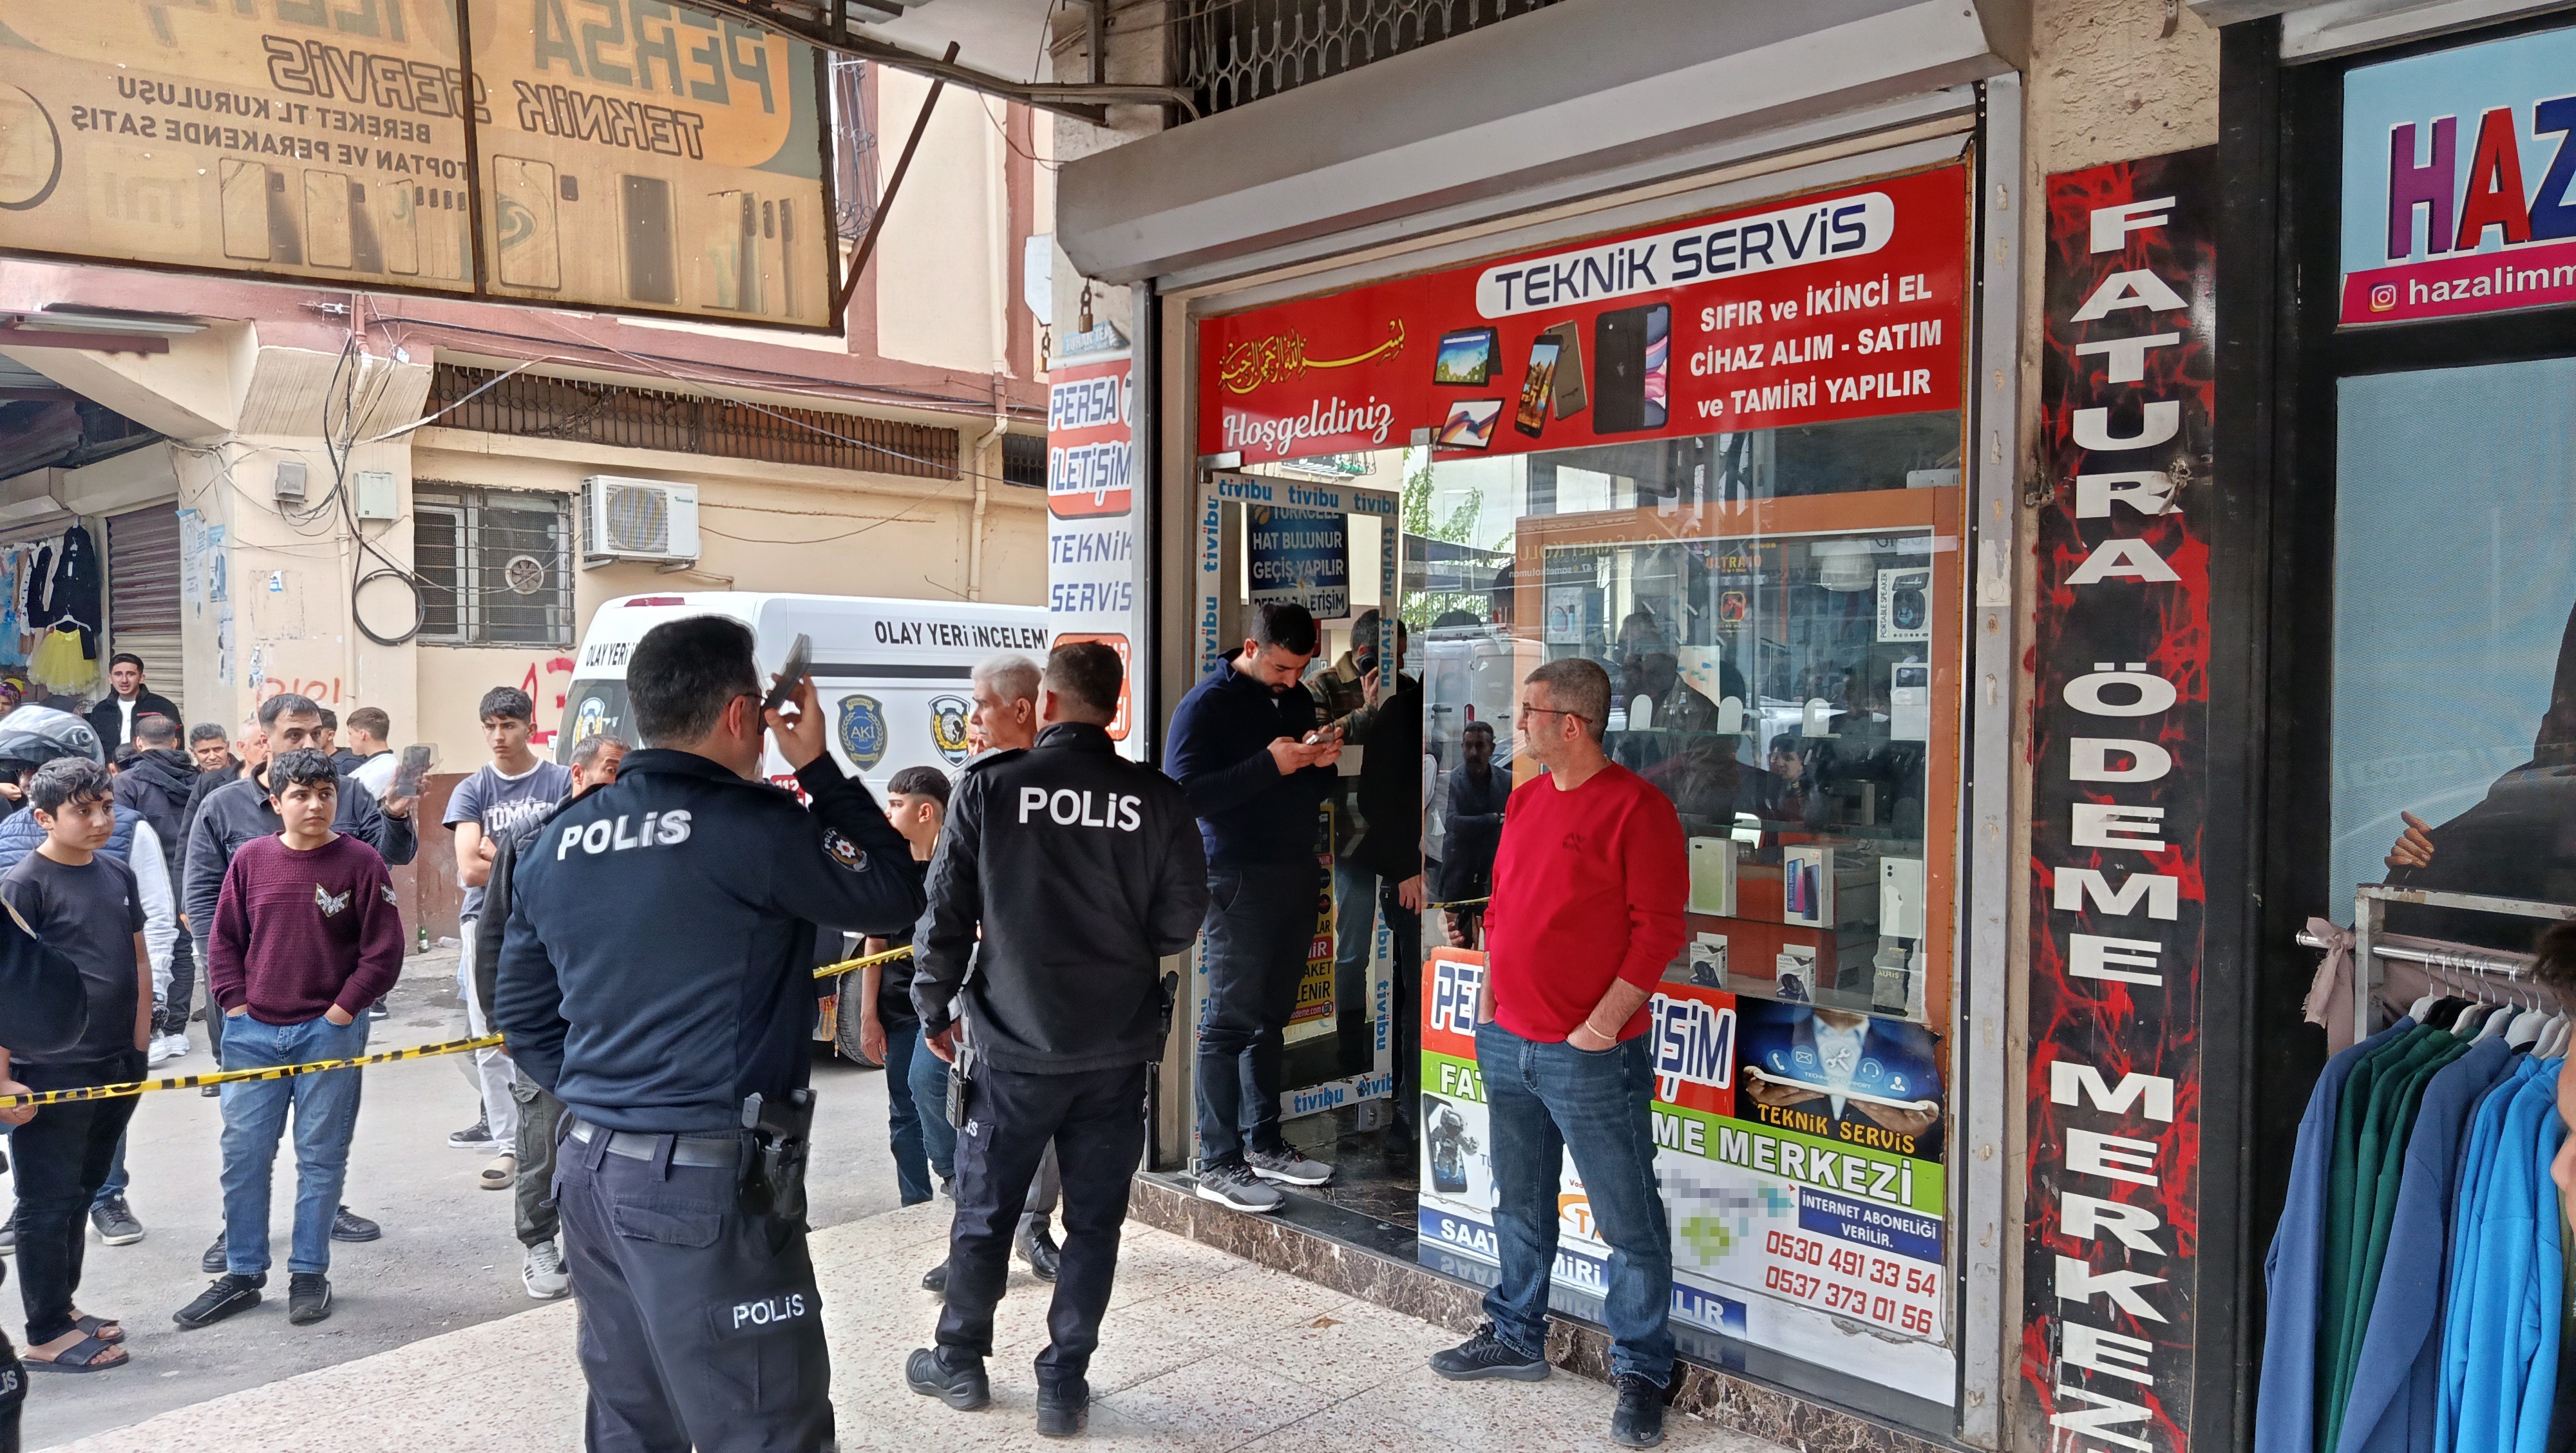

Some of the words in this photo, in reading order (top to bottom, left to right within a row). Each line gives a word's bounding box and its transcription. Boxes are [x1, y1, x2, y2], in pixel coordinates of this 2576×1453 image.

[1700, 299, 1763, 332] SIFIR
[1769, 299, 1798, 321] ve
[1899, 273, 1932, 303] EL
[1770, 334, 1833, 366] ALIM
[1857, 319, 1942, 354] SATIM
[1050, 378, 1117, 429] PERSA
[1698, 398, 1723, 419] ve
[1824, 368, 1931, 404] YAPILIR
[2064, 196, 2189, 585] FATURA
[1223, 396, 1394, 455] Hoşgeldiniz
[1253, 532, 1280, 550] HAT
[1282, 531, 1342, 549] BULUNUR
[875, 620, 922, 645] OLAY
[2053, 662, 2178, 987] ÖDEME
[1766, 1230, 1823, 1266] 0530
[1828, 1248, 1866, 1278] 491
[1870, 1258, 1900, 1287] 33
[1906, 1268, 1936, 1298] 54
[2049, 1060, 2174, 1453] MERKEZ
[1765, 1265, 1821, 1300] 0537
[1824, 1282, 1867, 1315] 373
[1872, 1296, 1896, 1324] 01
[1901, 1304, 1933, 1334] 56
